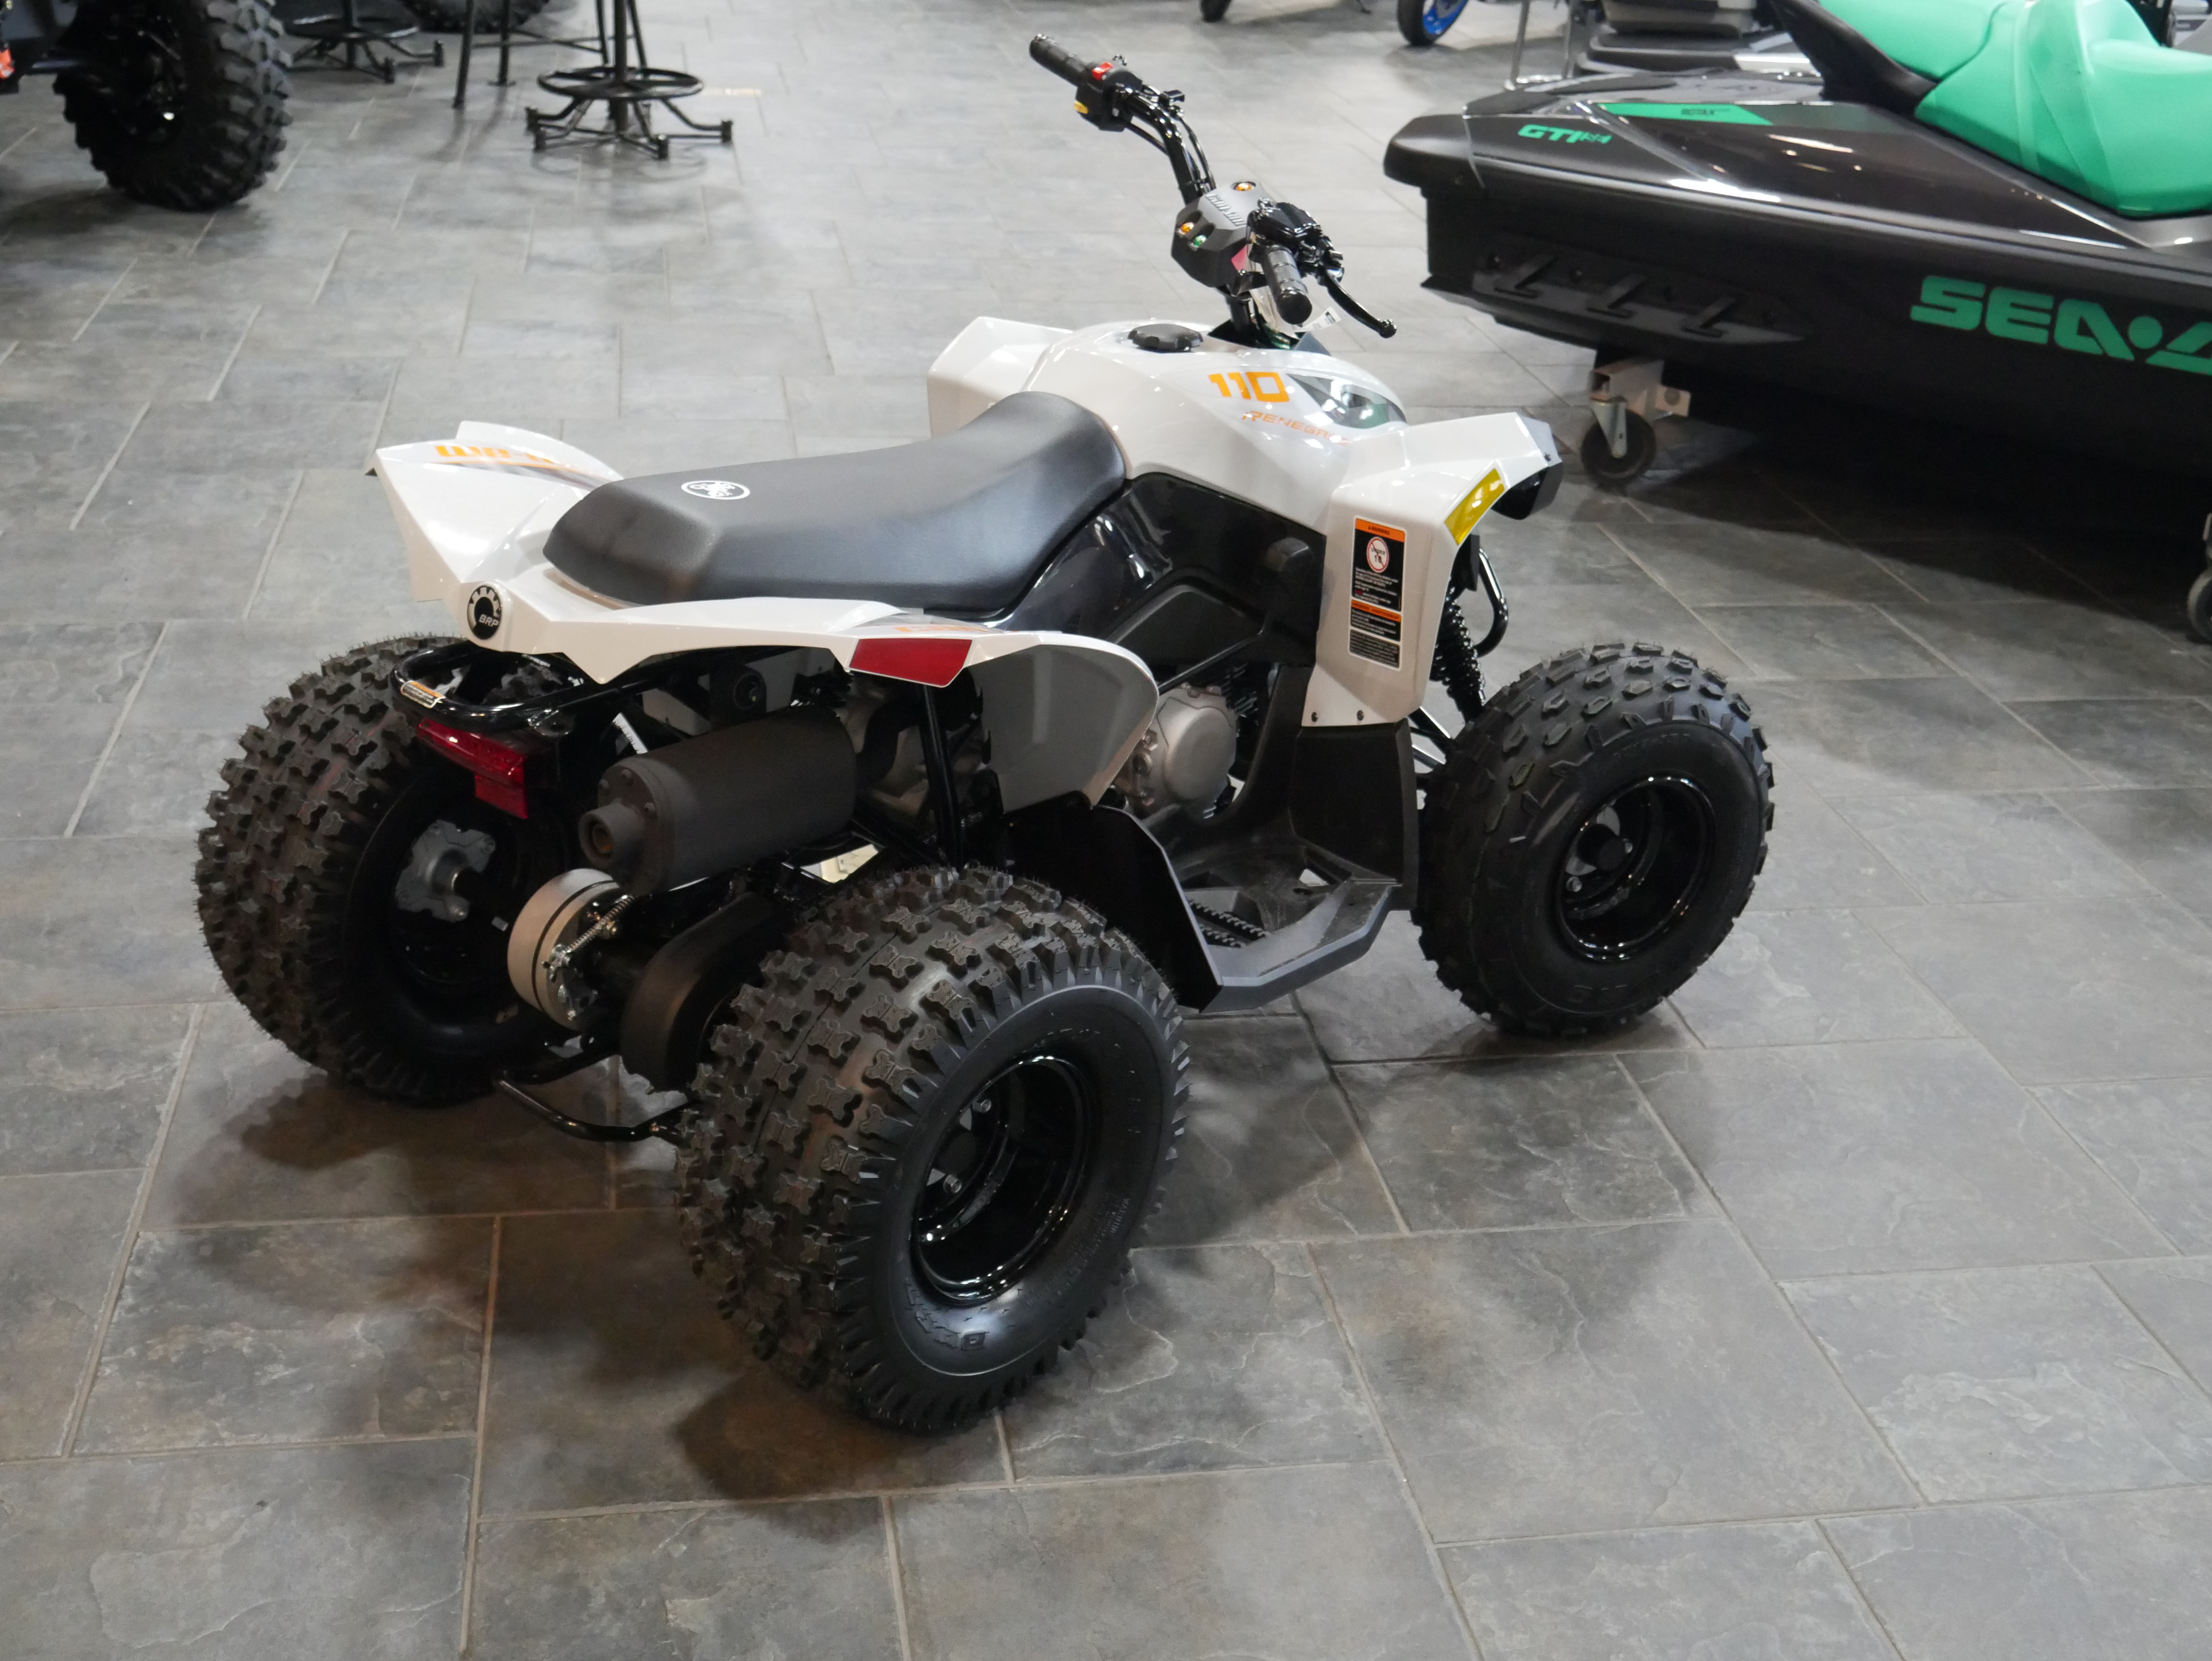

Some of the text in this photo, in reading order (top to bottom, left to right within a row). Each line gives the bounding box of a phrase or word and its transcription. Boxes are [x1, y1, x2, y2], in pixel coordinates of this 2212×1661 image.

[1517, 123, 1582, 144] GTI
[1208, 371, 1290, 403] 110
[478, 614, 500, 627] BRP
